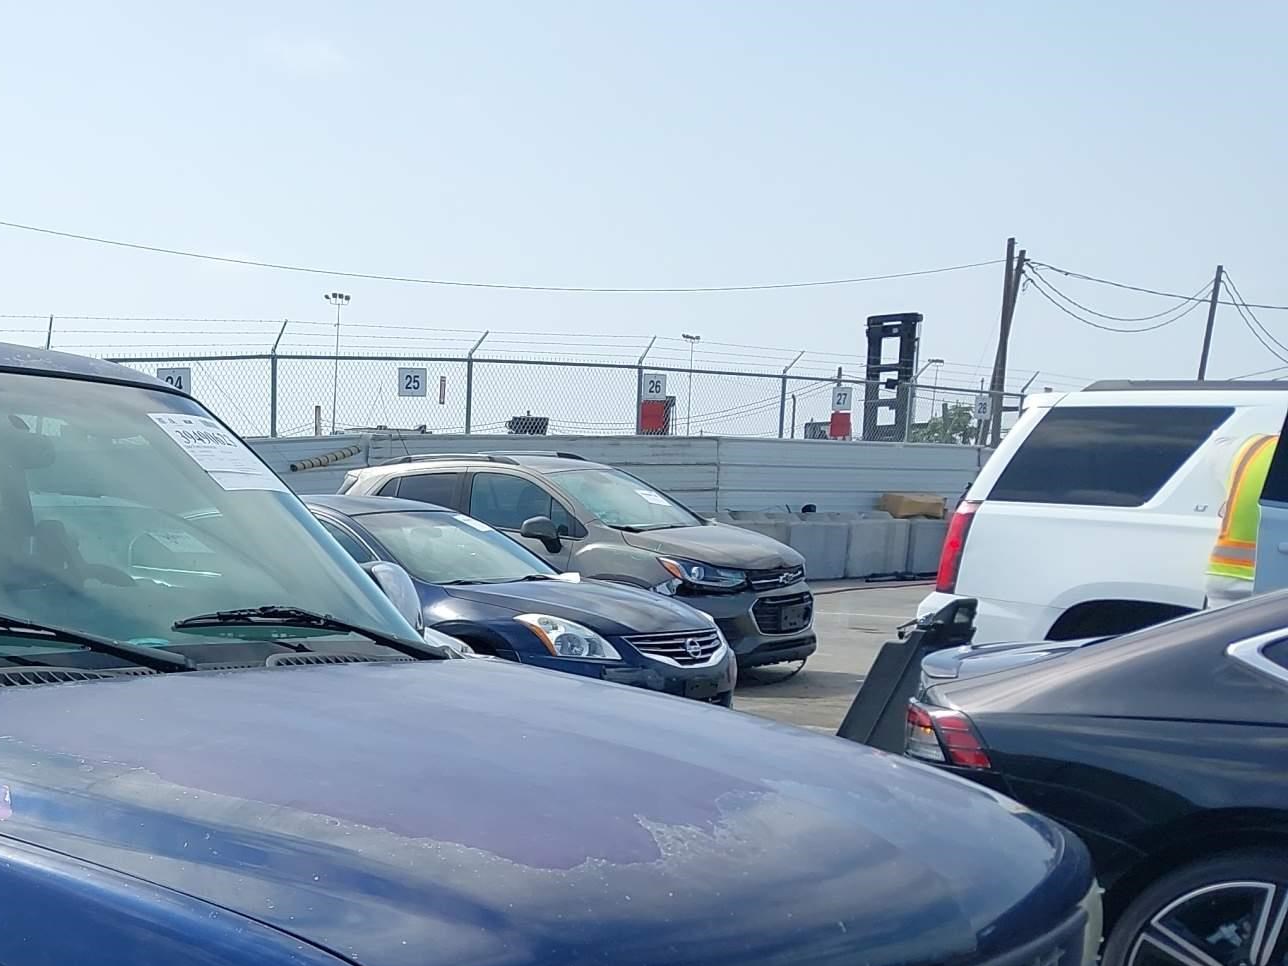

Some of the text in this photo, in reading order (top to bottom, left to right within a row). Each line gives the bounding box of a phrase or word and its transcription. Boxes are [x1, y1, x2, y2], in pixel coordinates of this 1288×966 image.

[405, 375, 420, 390] 25
[648, 380, 661, 393] 26
[836, 393, 847, 405] 27
